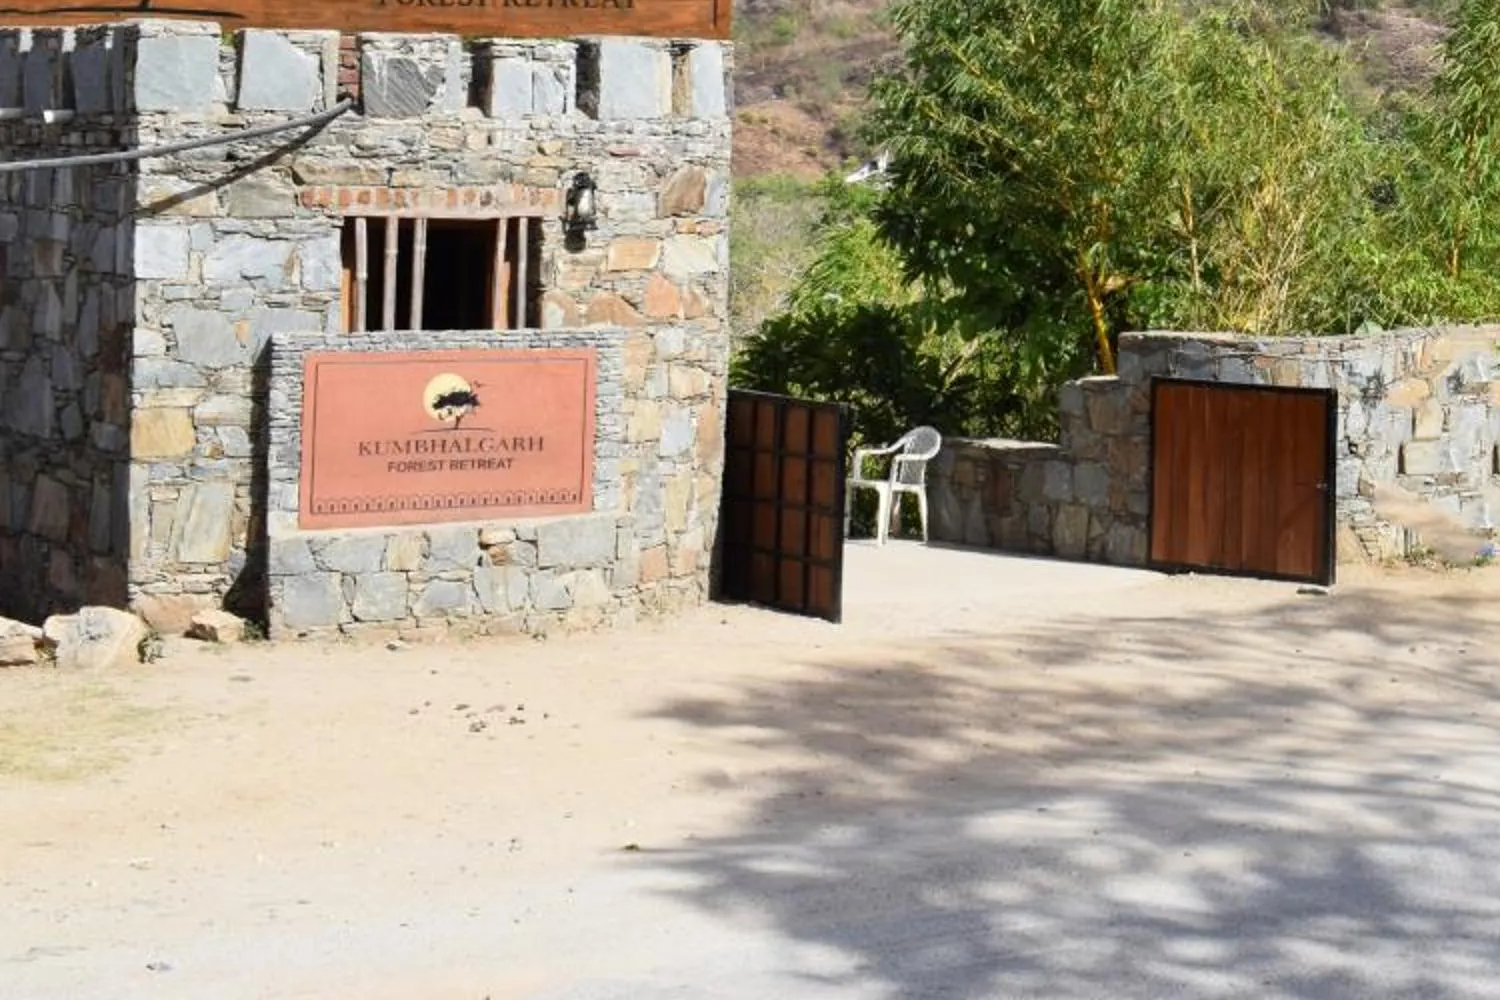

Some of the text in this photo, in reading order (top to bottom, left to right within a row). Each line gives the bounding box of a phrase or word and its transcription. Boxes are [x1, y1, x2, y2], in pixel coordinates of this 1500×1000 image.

[357, 435, 545, 457] KUMBHALGARH
[387, 457, 515, 473] FOREST RETREAT
